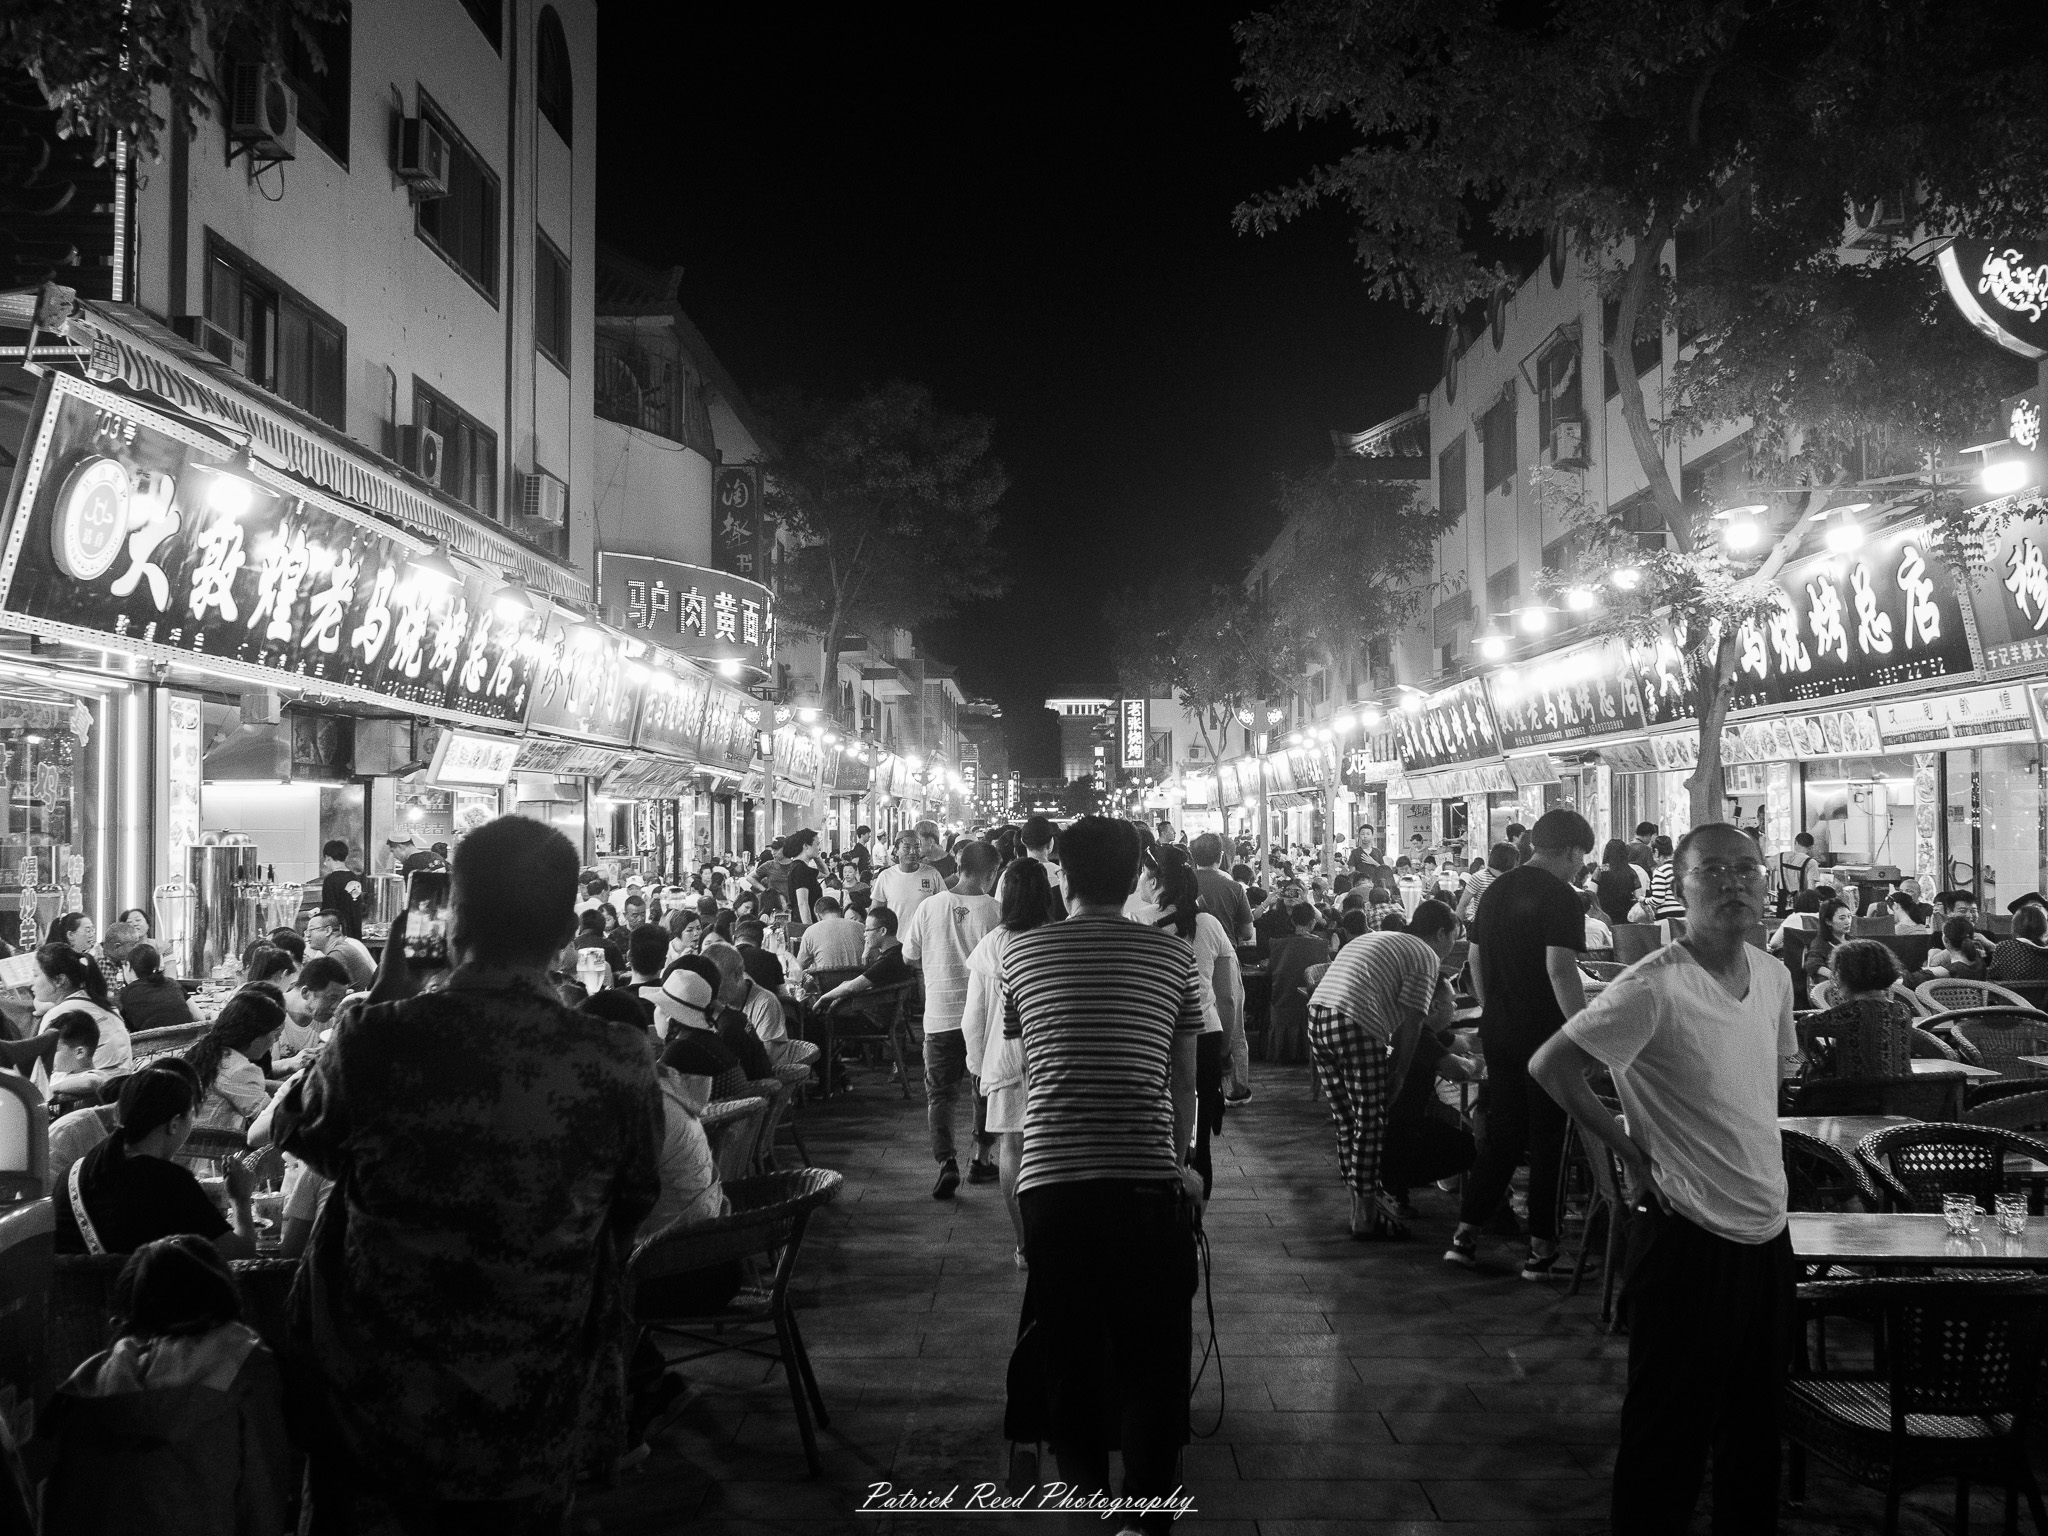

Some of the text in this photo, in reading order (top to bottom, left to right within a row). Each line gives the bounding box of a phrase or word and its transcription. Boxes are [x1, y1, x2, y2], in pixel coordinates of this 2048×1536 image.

[627, 580, 761, 647] 驴肉黄面
[1126, 702, 1143, 760] 老张烧烤
